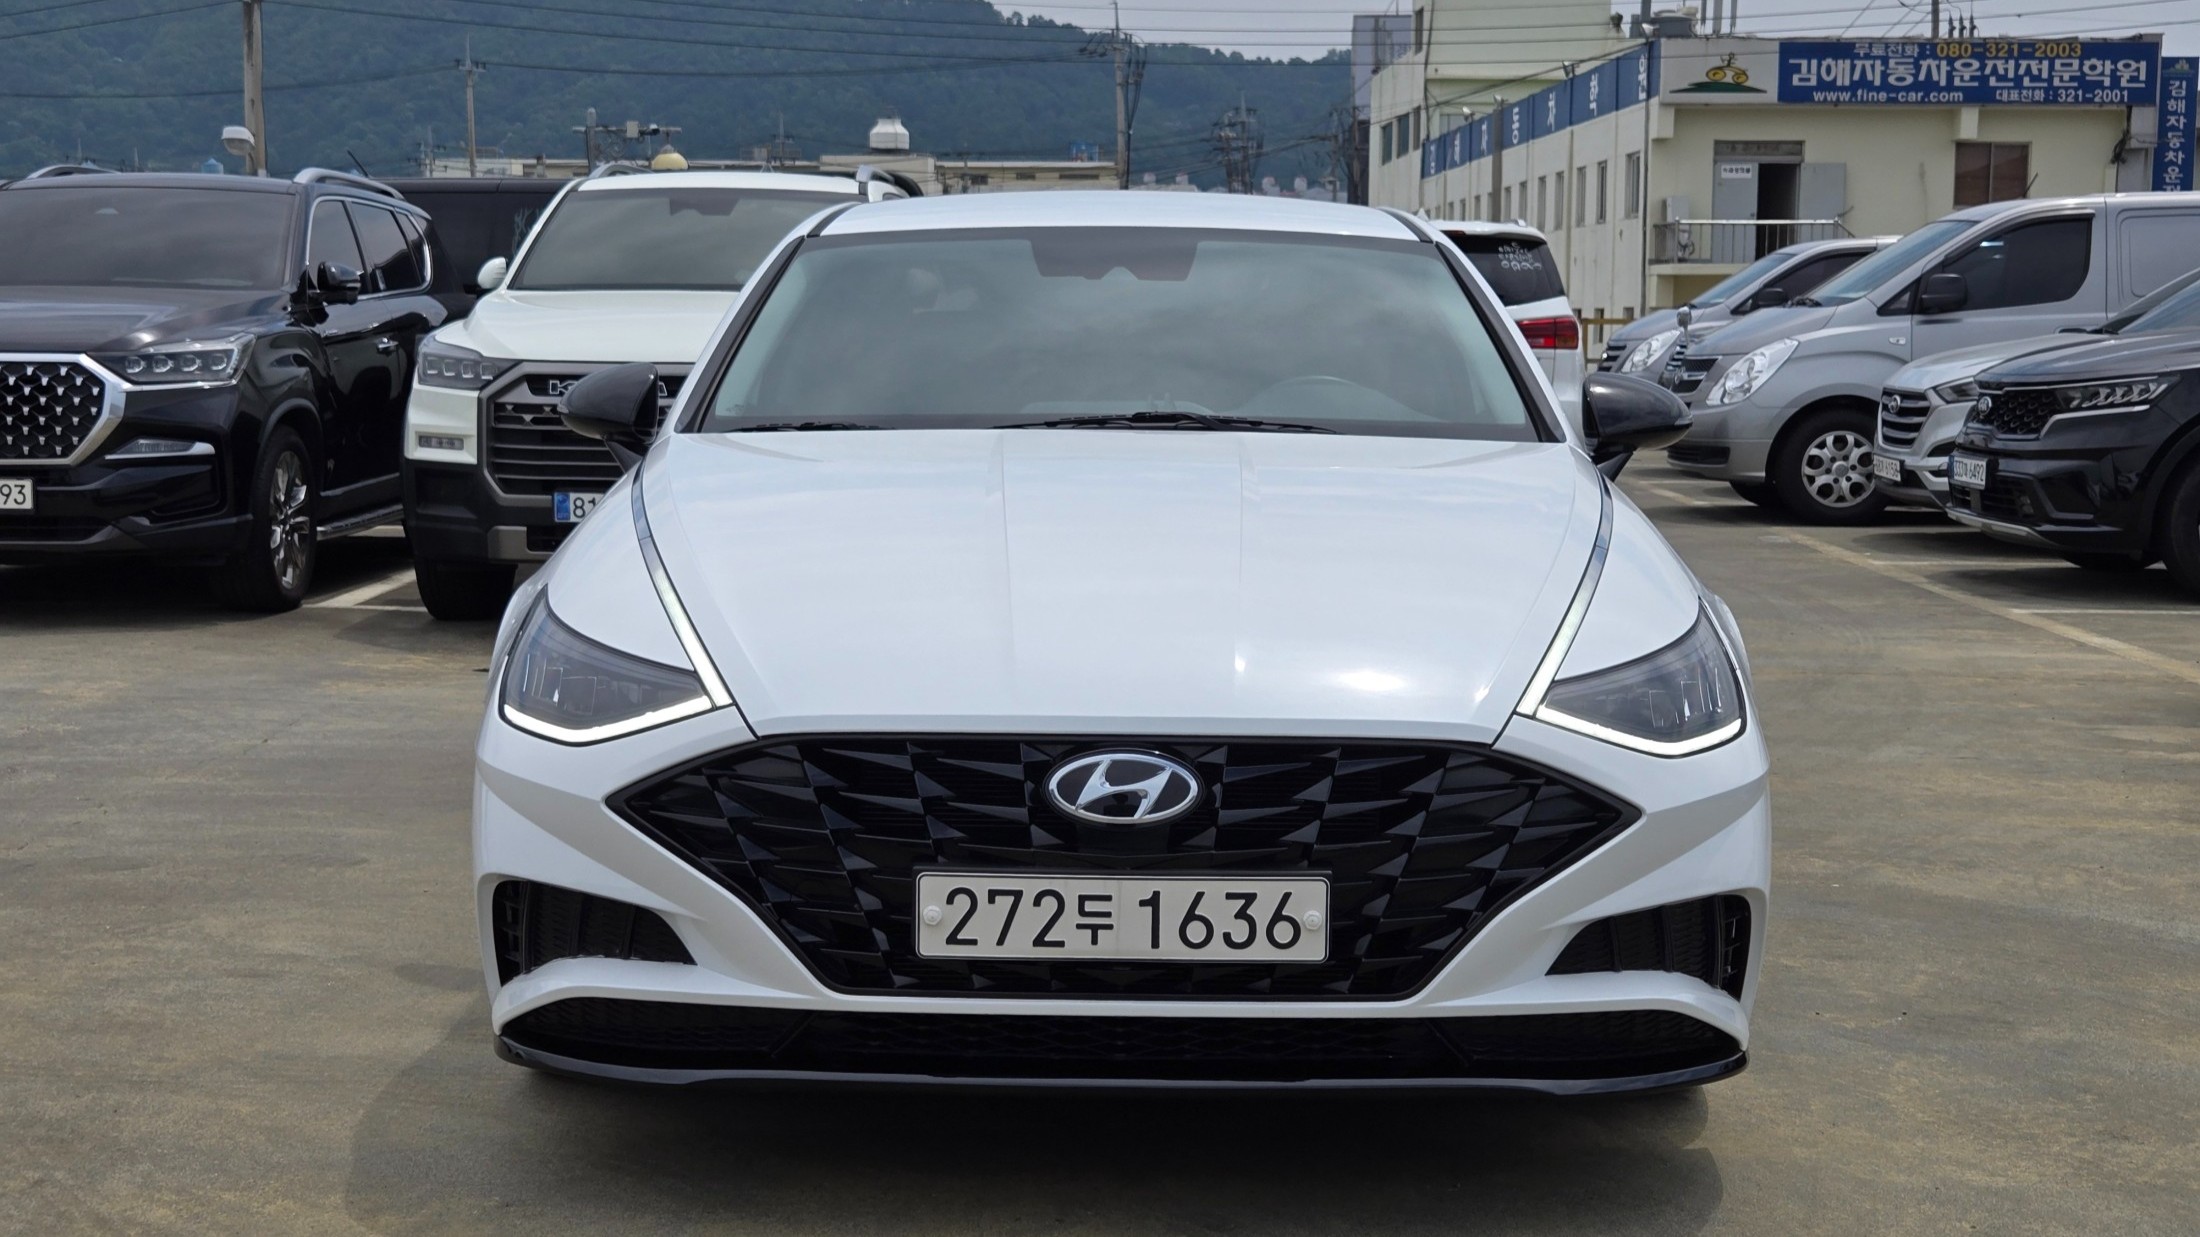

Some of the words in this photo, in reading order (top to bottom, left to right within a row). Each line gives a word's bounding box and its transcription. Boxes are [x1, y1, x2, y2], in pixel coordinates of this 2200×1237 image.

[1853, 42, 1919, 57] 무료전화
[1936, 42, 2082, 57] 080-321-2003
[1788, 57, 2147, 88] 김해자동차운전전문학원
[1812, 88, 1964, 103] www.fine-car.com
[1995, 88, 2045, 103] 대표전화
[2057, 88, 2129, 103] 321-2001
[945, 887, 1114, 948] 272두
[1138, 890, 1302, 950] 1636
